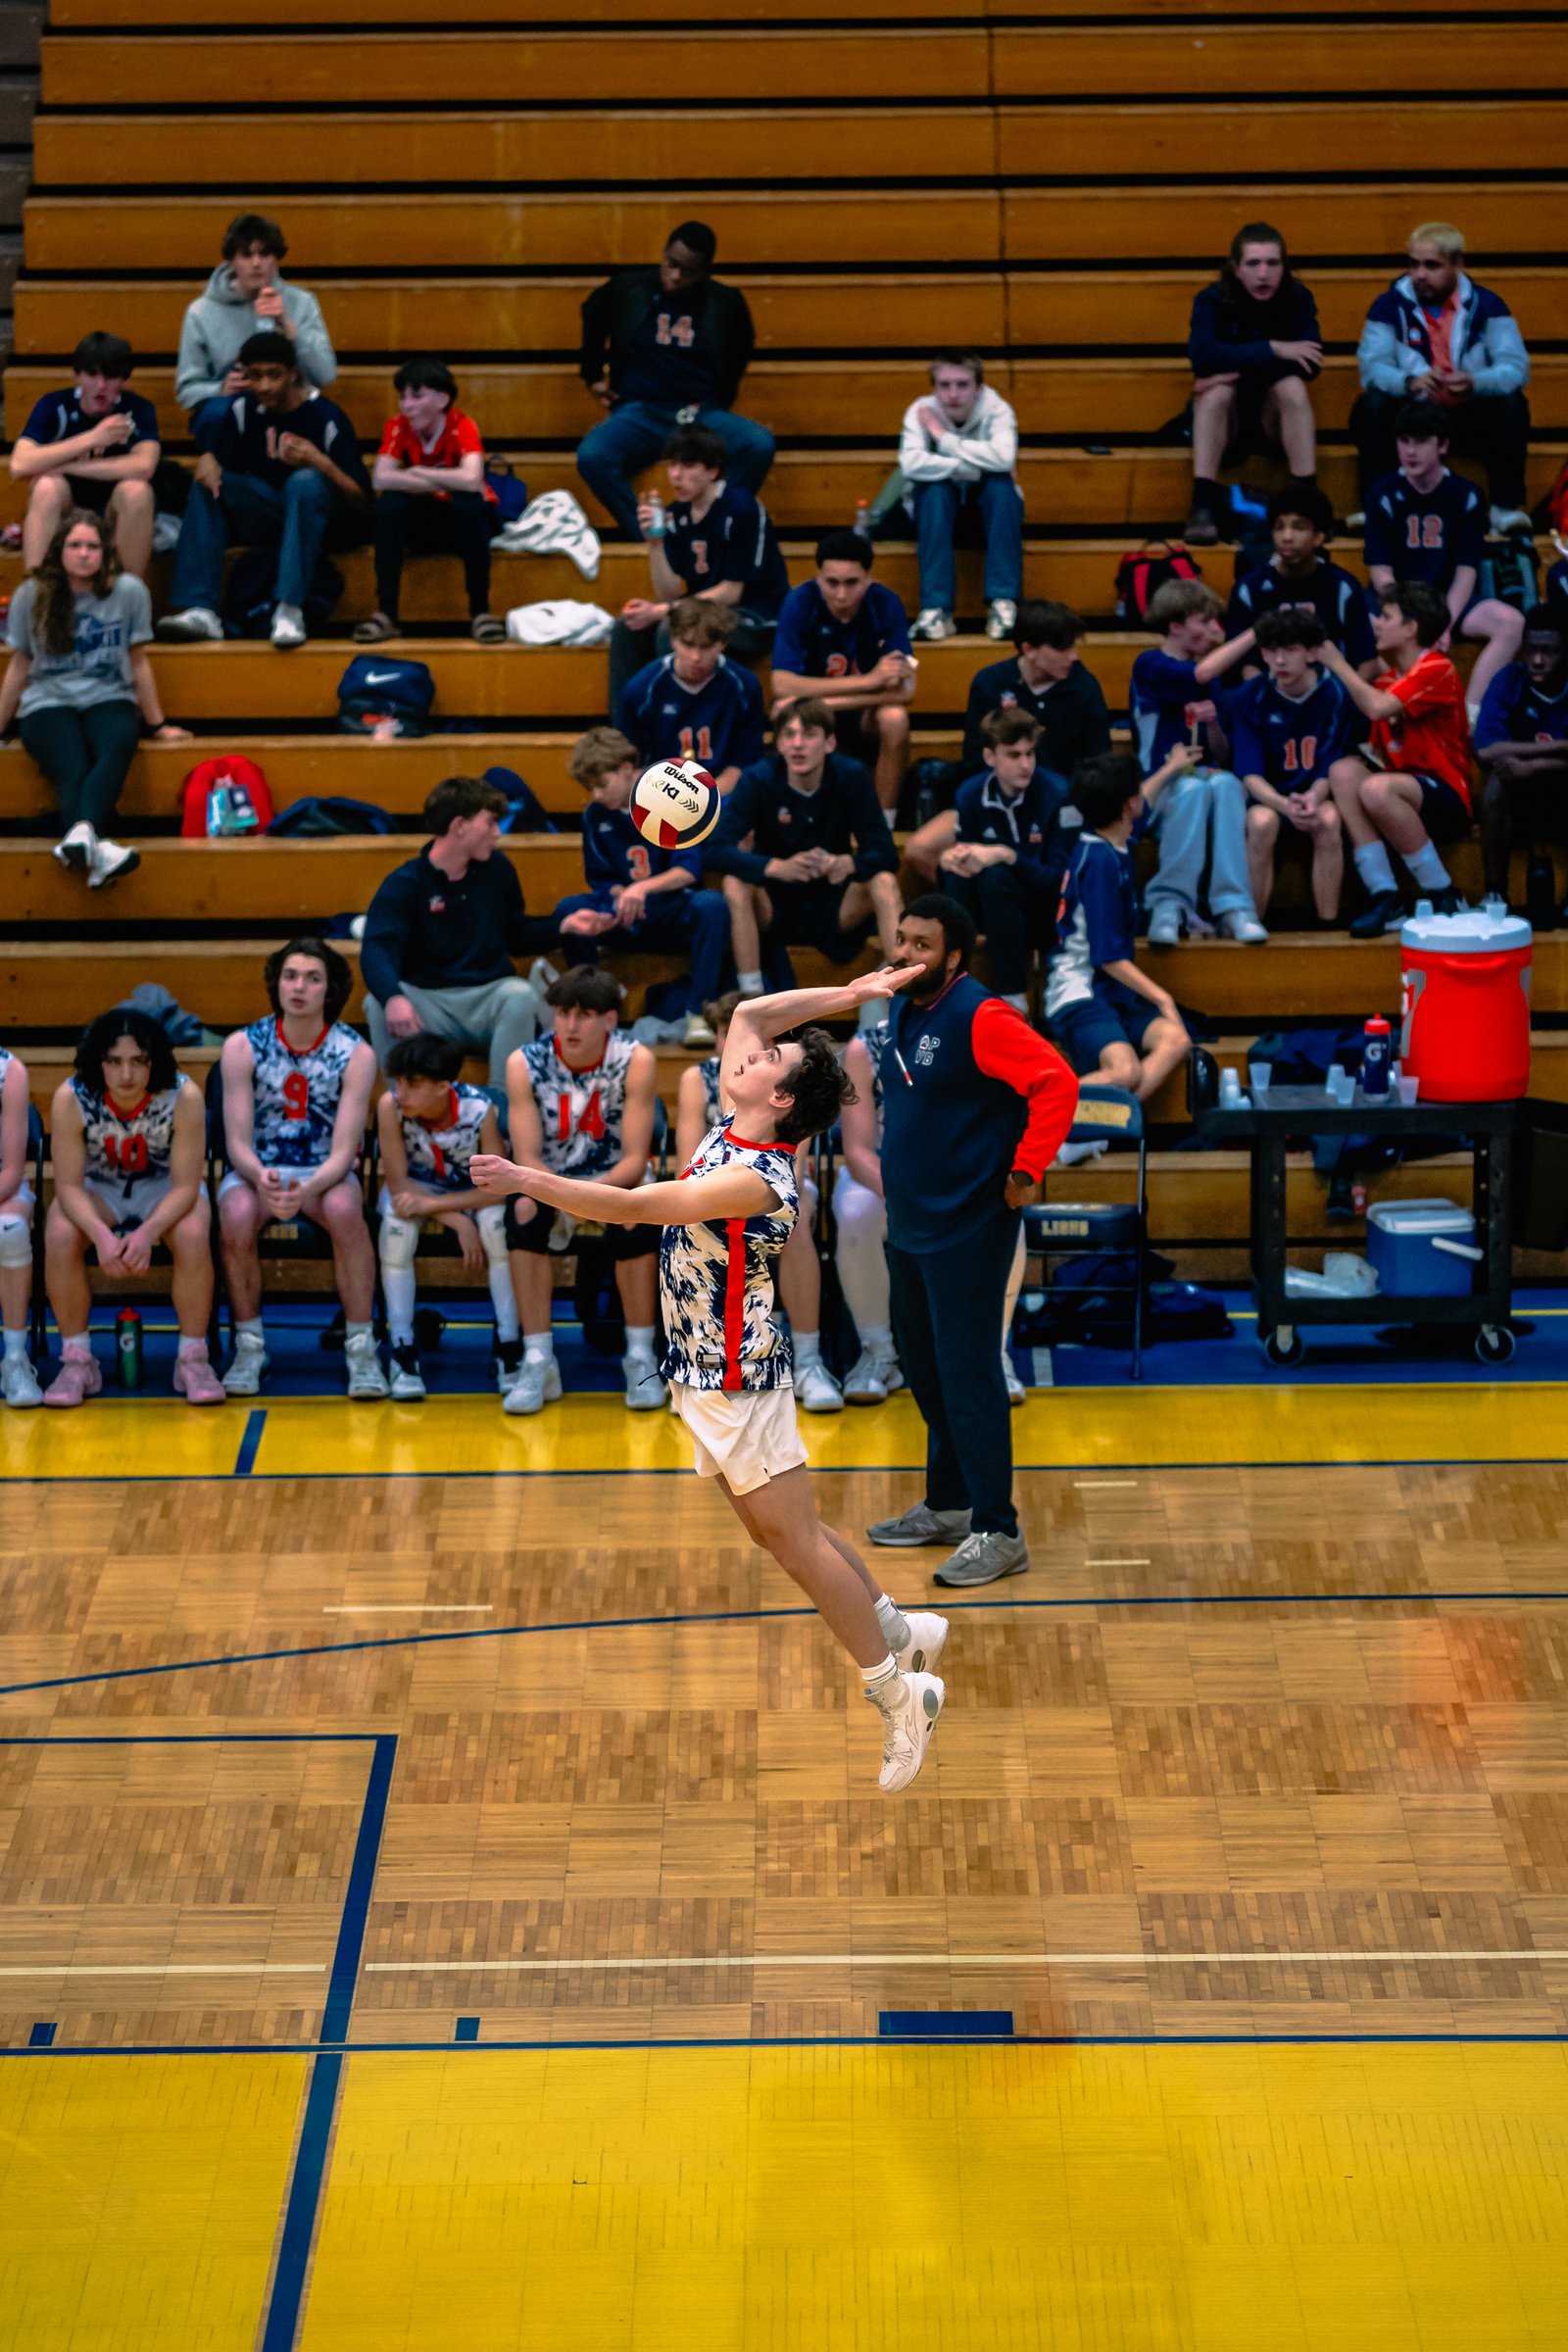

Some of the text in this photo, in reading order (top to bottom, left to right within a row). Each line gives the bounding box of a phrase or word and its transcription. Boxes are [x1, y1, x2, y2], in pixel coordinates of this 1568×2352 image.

[656, 314, 694, 347] 14
[1406, 514, 1444, 549] 12
[678, 726, 712, 760] 11
[1284, 736, 1316, 770] 10
[664, 766, 700, 795] Wilson
[626, 846, 651, 879] 3
[914, 1050, 934, 1066] VB
[1365, 1043, 1382, 1061] G
[282, 1071, 309, 1120] 9
[558, 1089, 606, 1142] 14
[104, 1134, 149, 1171] 10
